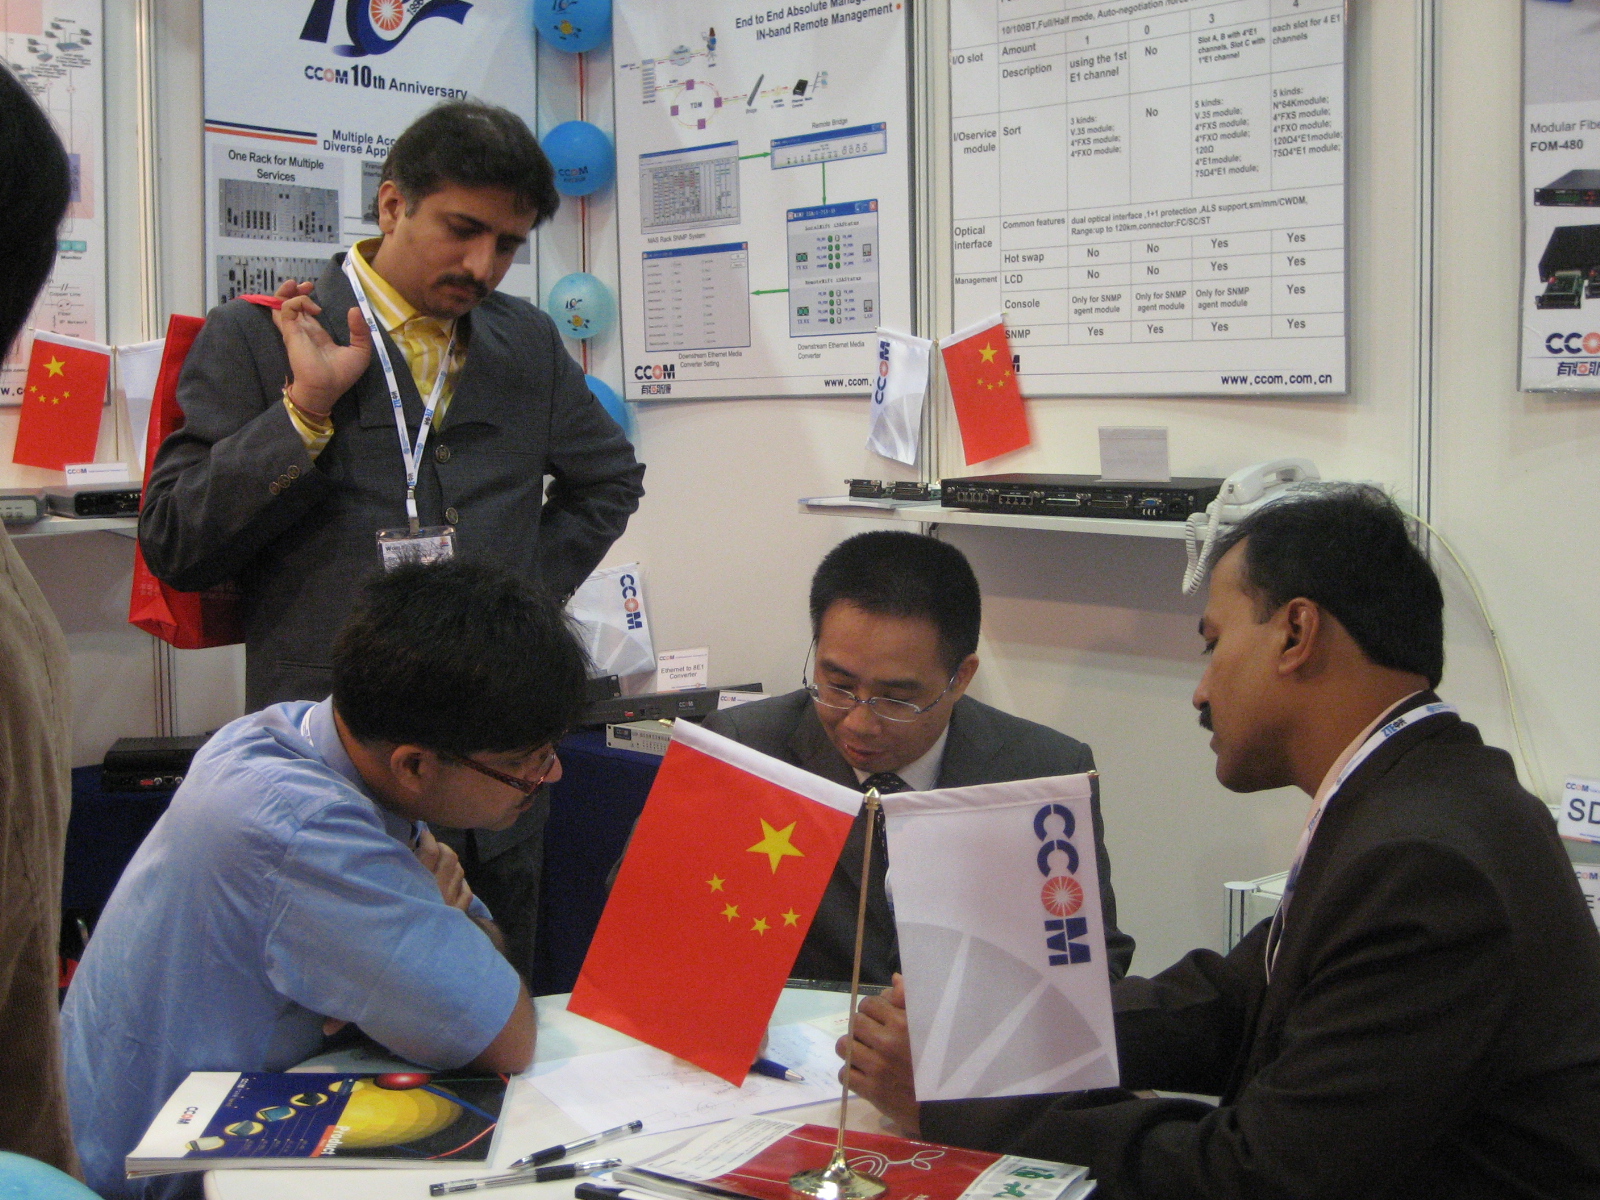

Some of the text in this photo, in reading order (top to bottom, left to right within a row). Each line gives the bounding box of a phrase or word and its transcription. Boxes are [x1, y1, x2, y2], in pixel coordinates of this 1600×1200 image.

[735, 2, 828, 29] End to End Absolute
[1209, 14, 1215, 24] 3
[756, 3, 893, 40] IN-band Remote Management
[1272, 14, 1341, 33] each slot for 4 E1
[1085, 36, 1089, 45] 1
[1198, 35, 1211, 44] Slot
[1227, 30, 1241, 39] with
[1272, 33, 1308, 45] channels
[1230, 37, 1265, 49] Slot C with
[1002, 43, 1036, 56] Amount
[1144, 46, 1158, 57] No
[952, 53, 983, 65] I/O slot
[1069, 51, 1127, 69] using the 1st
[1214, 51, 1240, 62] channel
[1002, 63, 1052, 79] Description
[1070, 66, 1119, 83] E1 channel
[304, 64, 468, 101] CCOM 10th Anniversary
[1279, 87, 1304, 97] kinds:
[1146, 108, 1158, 118] No
[812, 121, 830, 129] Remote
[1530, 122, 1576, 133] Modular
[1003, 126, 1021, 136] Sort
[333, 129, 373, 145] Multiple
[323, 140, 362, 154] Diverse
[963, 142, 996, 155] module
[1530, 139, 1583, 151] FOM-480
[228, 149, 324, 171] One Rack for Multiple
[257, 169, 296, 182] Services
[1071, 206, 1197, 225] dual optical interface protection
[1003, 216, 1066, 230] Common features
[954, 226, 986, 239] Optical
[1106, 225, 1113, 233] to
[1287, 232, 1306, 243] Yes
[954, 239, 992, 250] interface
[1146, 243, 1160, 254] No
[1211, 238, 1229, 249] Yes
[1004, 253, 1044, 263] Hot swap
[1087, 248, 1100, 258] No
[1210, 261, 1228, 271] Yes
[1287, 256, 1306, 266] Yes
[1087, 269, 1100, 279] No
[1146, 265, 1160, 275] No
[955, 275, 997, 286] Management
[1004, 274, 1023, 285] LCD
[1195, 287, 1249, 299] Only for SNMP
[1286, 284, 1306, 294] Yes
[1071, 294, 1122, 305] Only for SNMP
[1135, 290, 1187, 301] Only for SNMP
[1004, 299, 1040, 309] Console
[1137, 302, 1185, 313] agent module
[1198, 299, 1248, 310] agent module
[1074, 305, 1120, 315] agent module
[1147, 324, 1164, 334] Yes
[1211, 322, 1229, 332] Yes
[1287, 319, 1306, 329] Yes
[1005, 329, 1031, 339] SNMP
[1088, 327, 1104, 336] Yes
[634, 364, 675, 380] CCOM
[875, 340, 890, 405] CCOM
[824, 378, 874, 387] www.ccom.
[1221, 374, 1332, 386] www.ccom.com.cn
[620, 573, 643, 630] CCOM
[661, 665, 685, 673] Ethernet
[1566, 782, 1589, 792] CCOM
[1576, 871, 1598, 880] COM
[1033, 803, 1091, 966] CCOM
[177, 1106, 198, 1125] CCOM
[321, 1125, 350, 1155] Product
